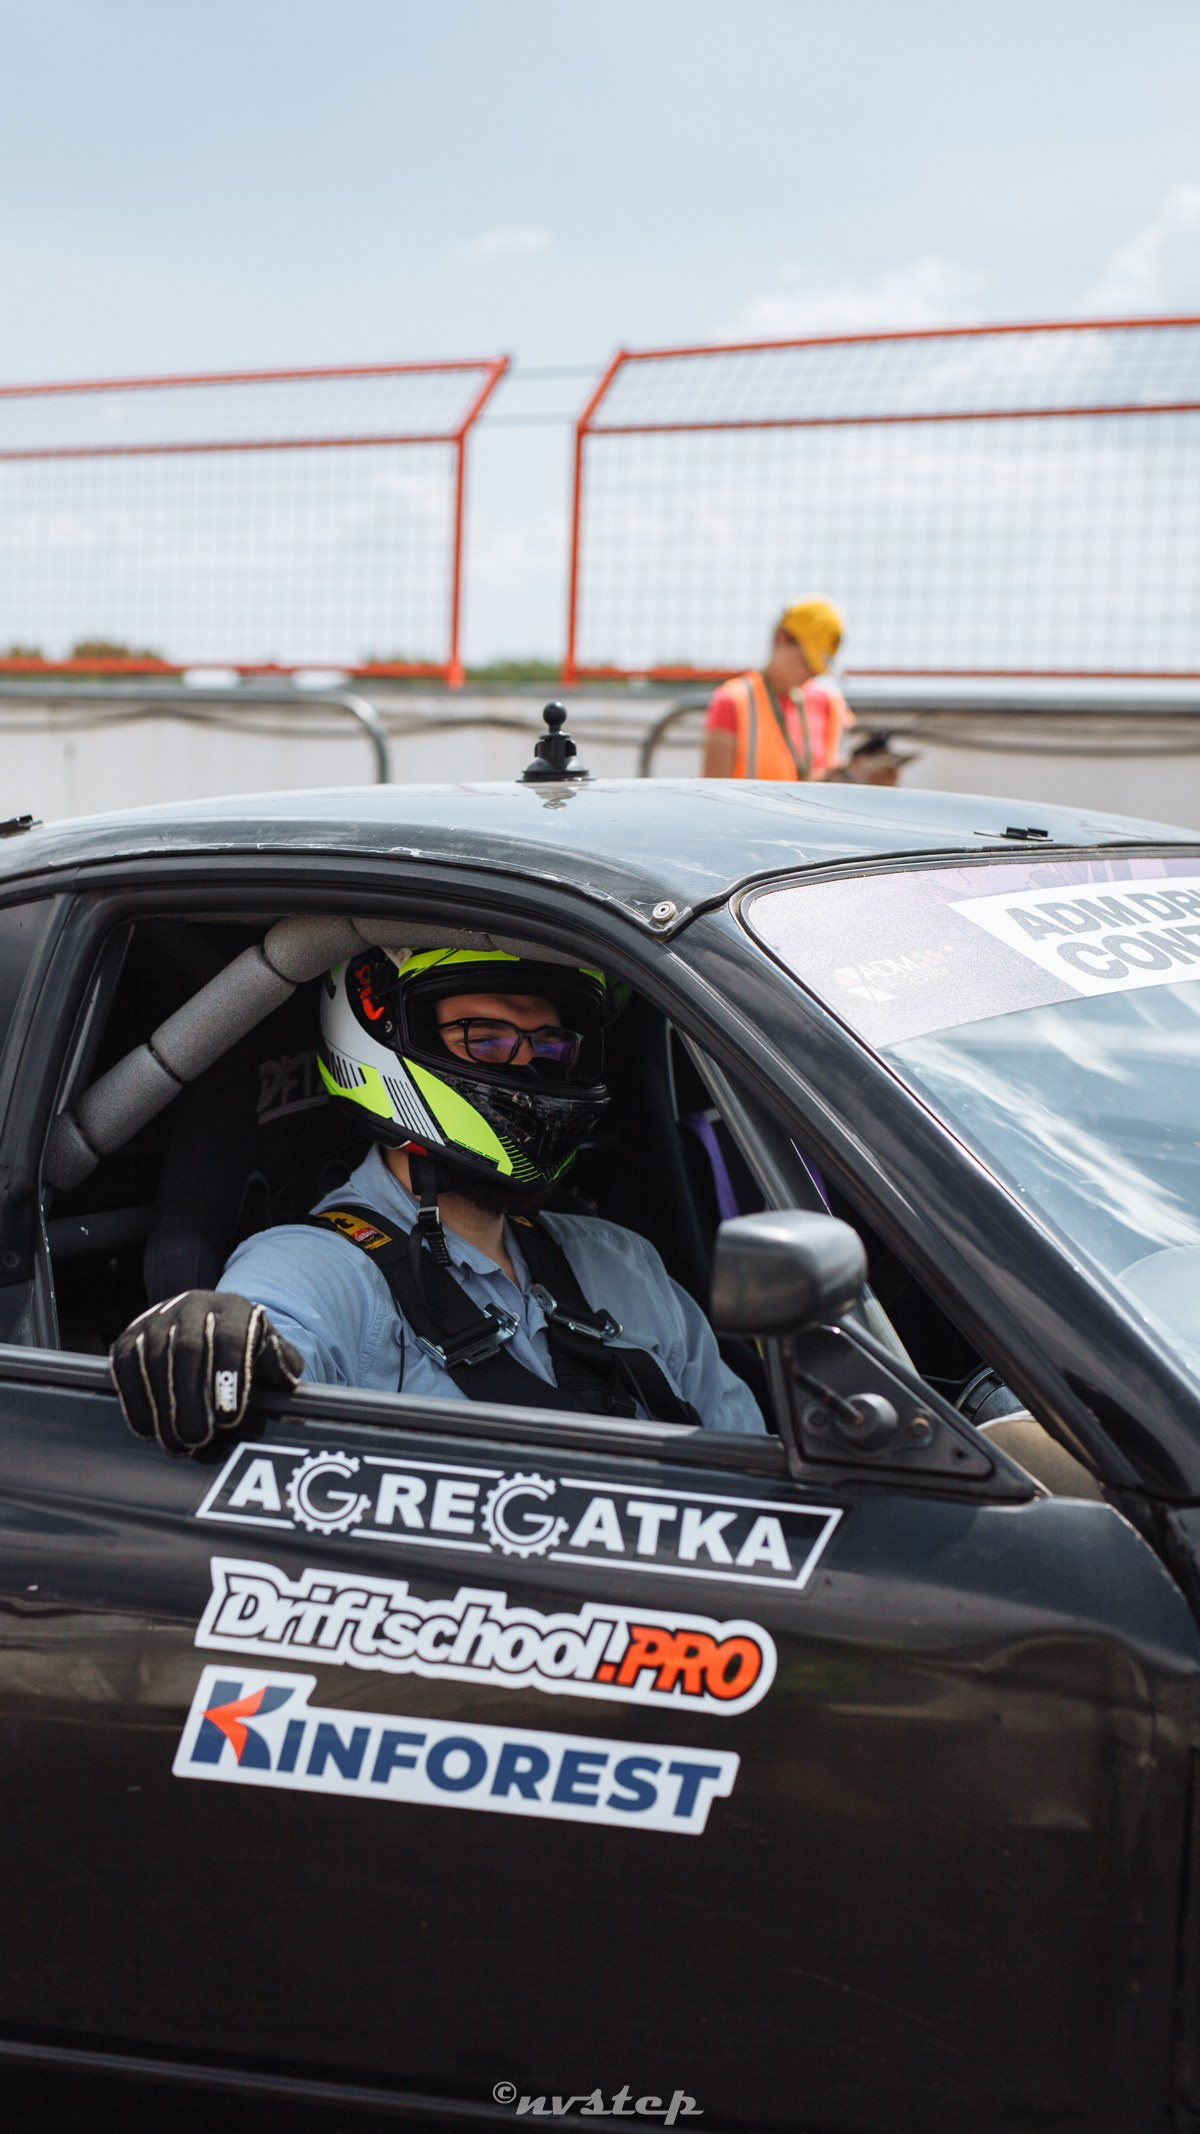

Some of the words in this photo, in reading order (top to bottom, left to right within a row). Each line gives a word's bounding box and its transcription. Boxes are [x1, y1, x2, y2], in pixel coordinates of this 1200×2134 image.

[1006, 896, 1152, 941] ADM
[1123, 889, 1200, 922] DR
[858, 955, 921, 980] ADM
[228, 1451, 792, 1571] AGREGATKA
[190, 1680, 721, 1819] KINFOREST
